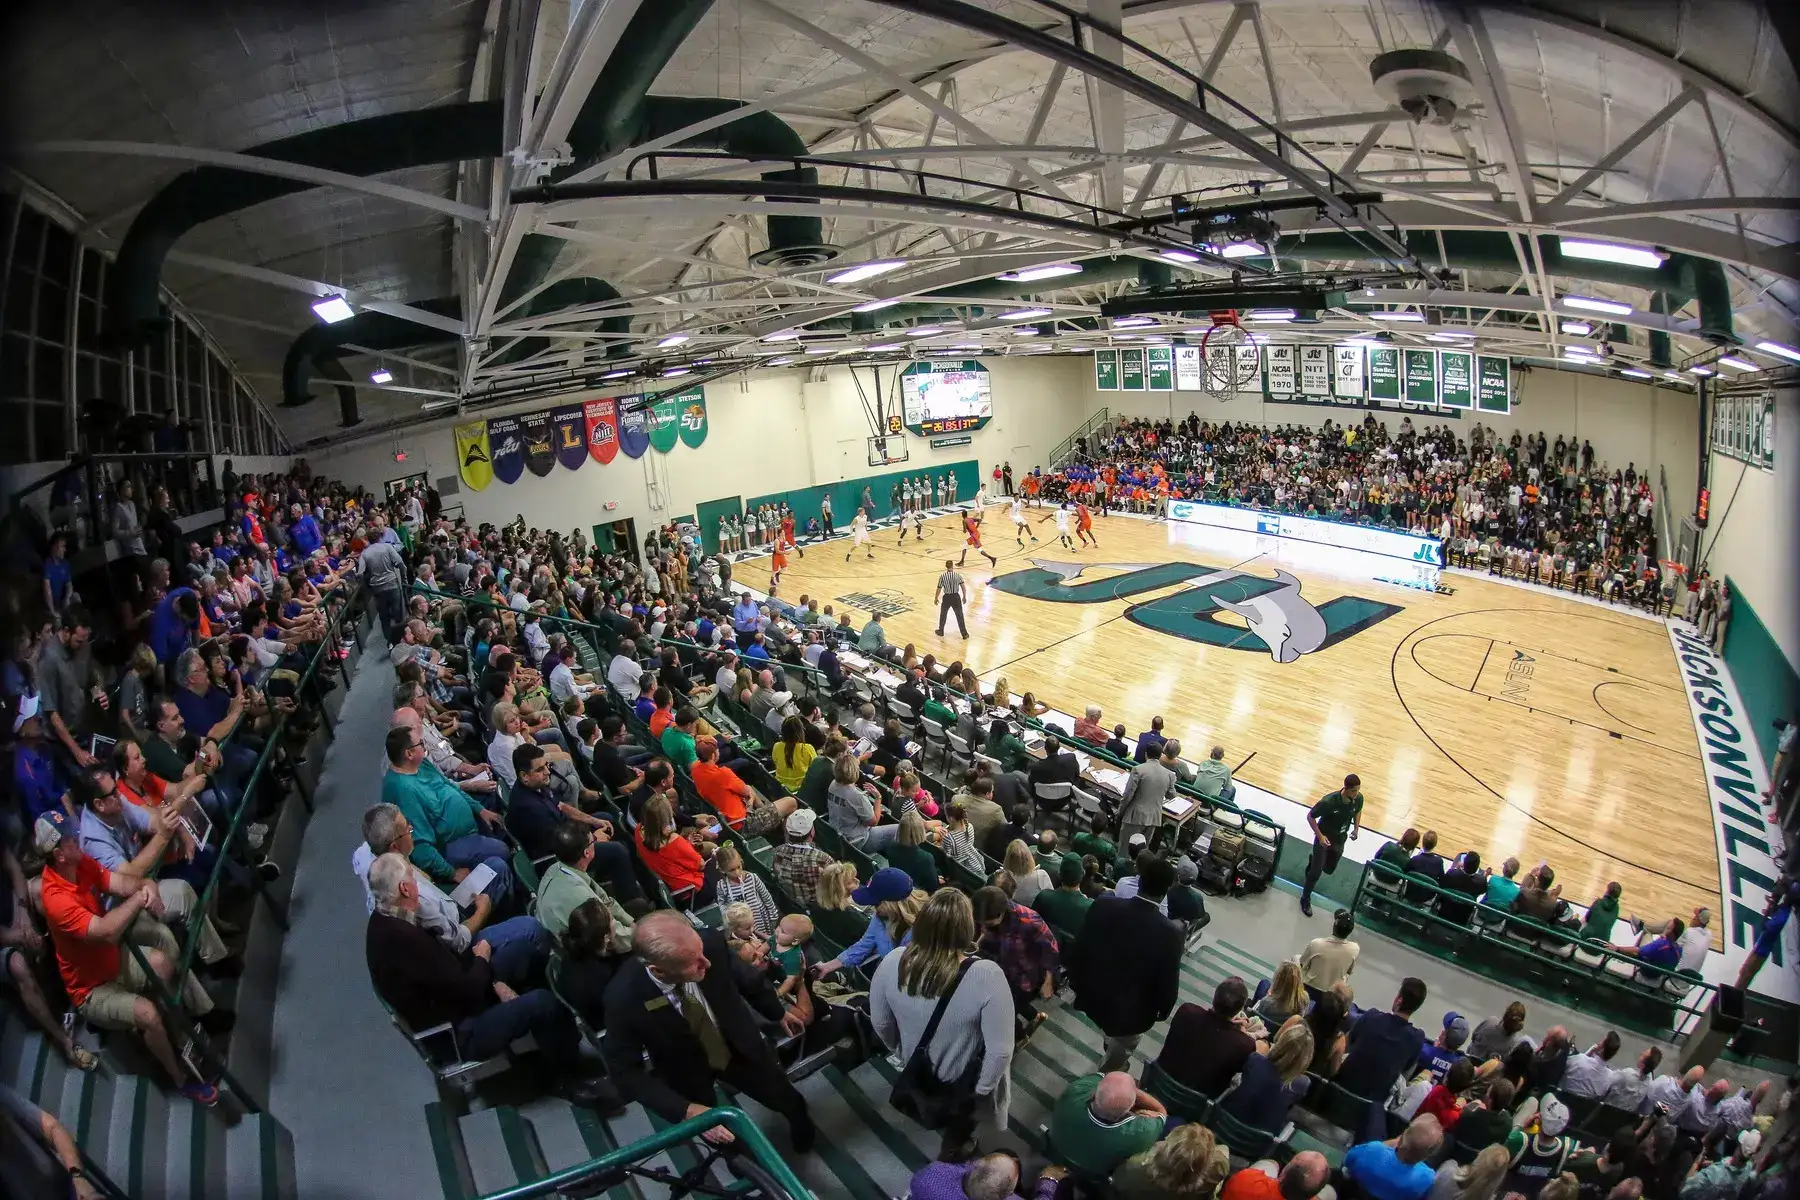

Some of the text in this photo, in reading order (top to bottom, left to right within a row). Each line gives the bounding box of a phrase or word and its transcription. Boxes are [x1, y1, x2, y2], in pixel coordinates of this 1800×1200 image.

[1271, 365, 1291, 373] NCAA
[1305, 365, 1325, 373] NIT
[1409, 369, 1432, 377] ASUN
[1271, 381, 1292, 389] 1970
[1482, 377, 1505, 388] NCAA
[621, 396, 640, 405] NORTH
[678, 394, 702, 402] STETSON
[520, 411, 551, 422] KENNESAW
[554, 411, 583, 422] LIPSCOMB
[493, 419, 515, 428] FLORIDA
[527, 419, 545, 428] STATE
[489, 427, 502, 435] GULF
[503, 423, 520, 433] COAST
[560, 423, 582, 449] L
